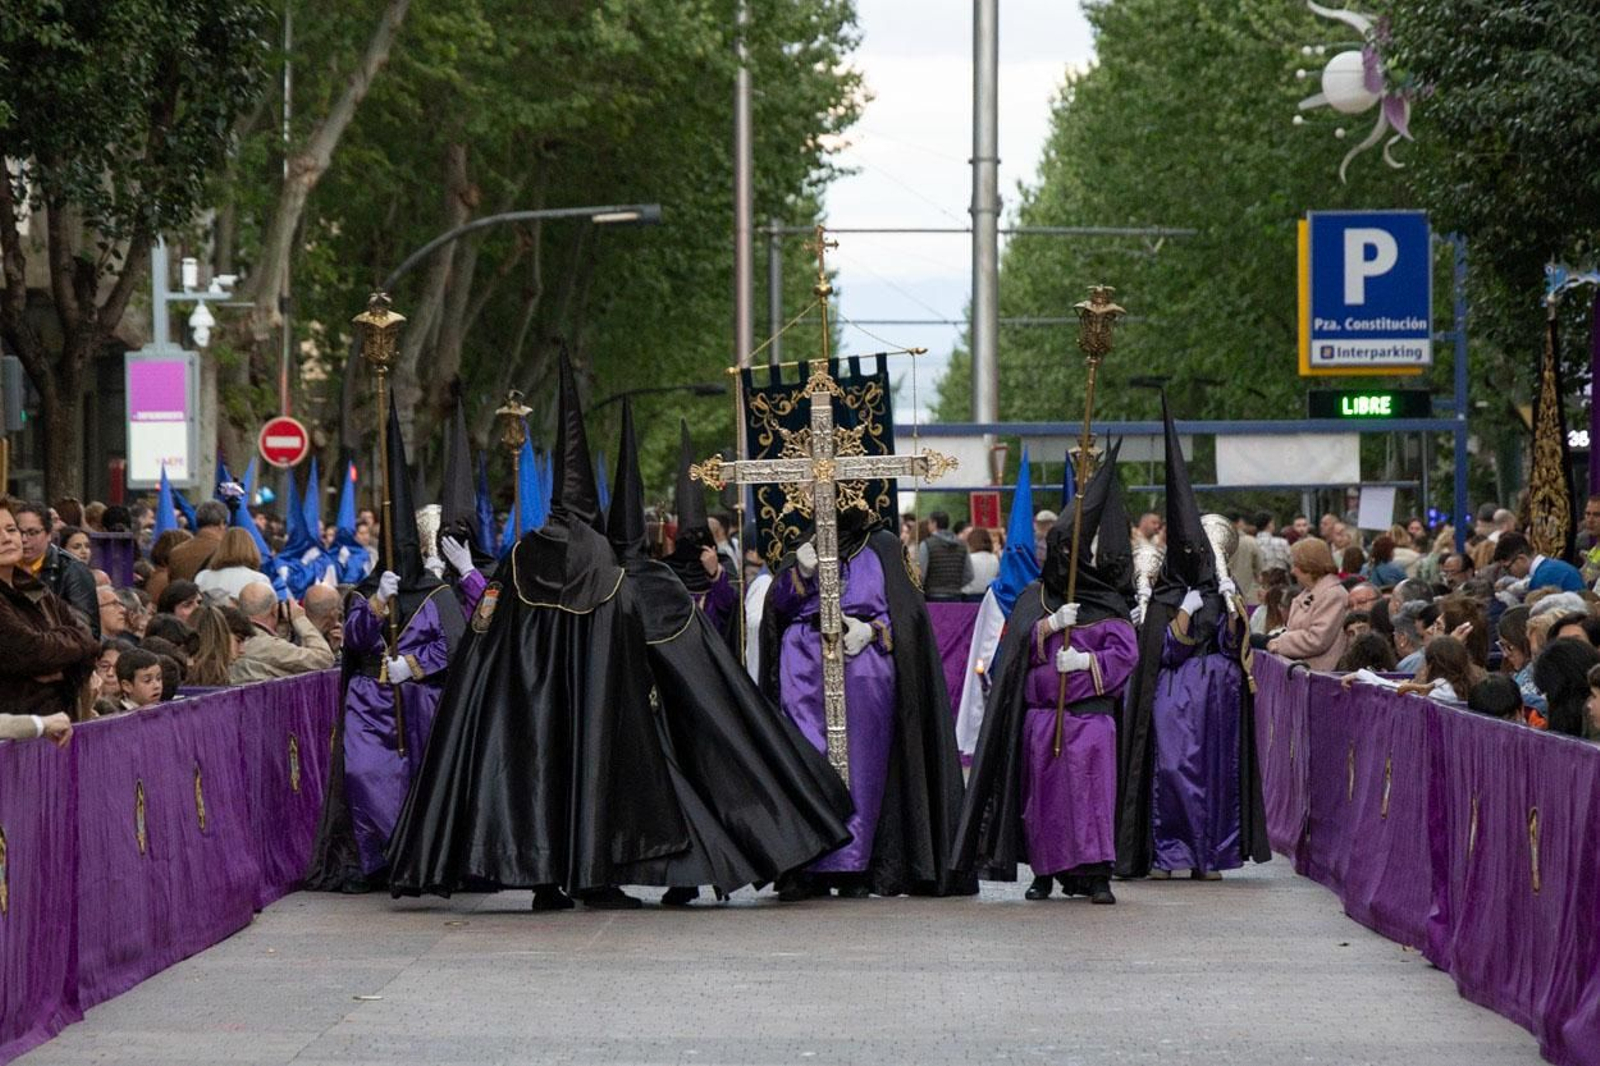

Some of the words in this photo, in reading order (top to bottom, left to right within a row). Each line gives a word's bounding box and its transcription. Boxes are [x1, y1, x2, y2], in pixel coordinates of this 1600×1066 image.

[1344, 228, 1398, 305] P
[1314, 318, 1342, 331] Pza.
[1344, 316, 1428, 331] Constitución
[1337, 344, 1423, 360] Interparking
[1342, 396, 1392, 415] LIBRE
